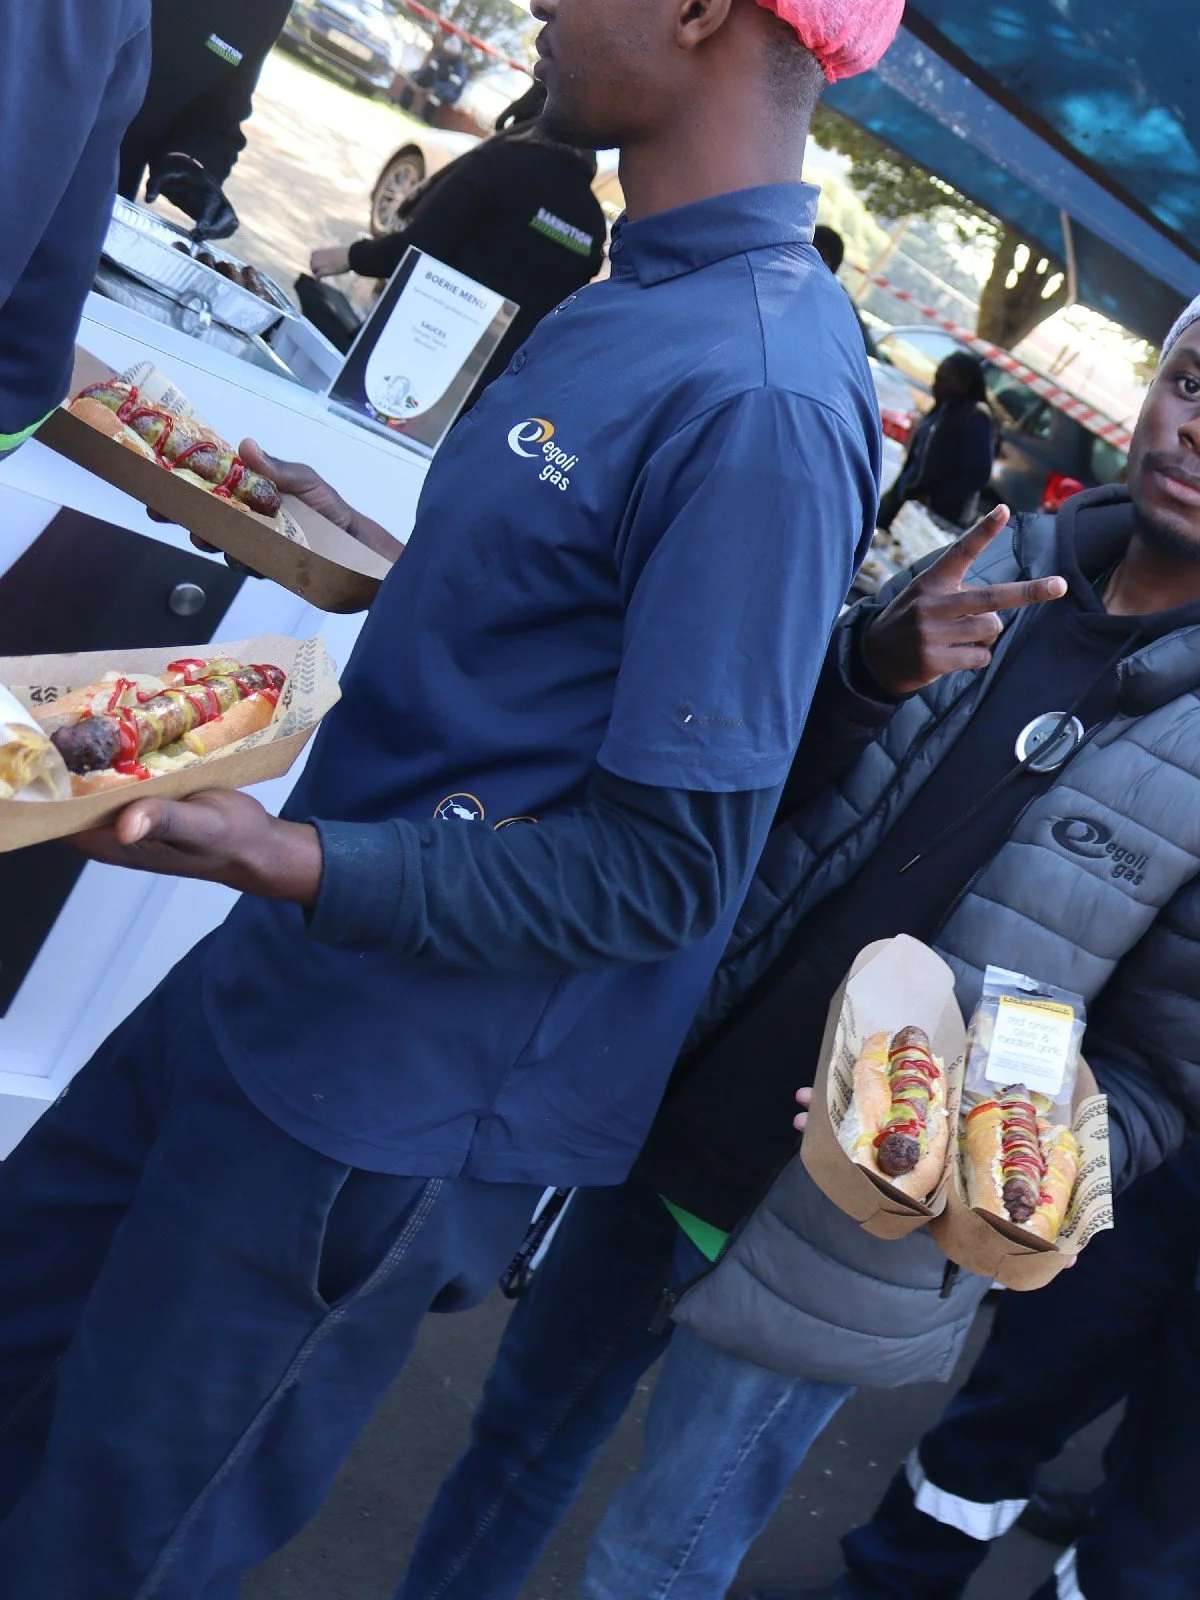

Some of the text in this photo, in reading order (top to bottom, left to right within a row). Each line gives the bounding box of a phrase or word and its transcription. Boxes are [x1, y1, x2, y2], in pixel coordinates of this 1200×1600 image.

[425, 271, 488, 309] BOERIE MENU
[541, 441, 579, 472] egoli
[538, 464, 570, 491] gas
[1105, 842, 1149, 871] egoli
[1111, 862, 1143, 886] gas
[1041, 1033, 1049, 1043] &
